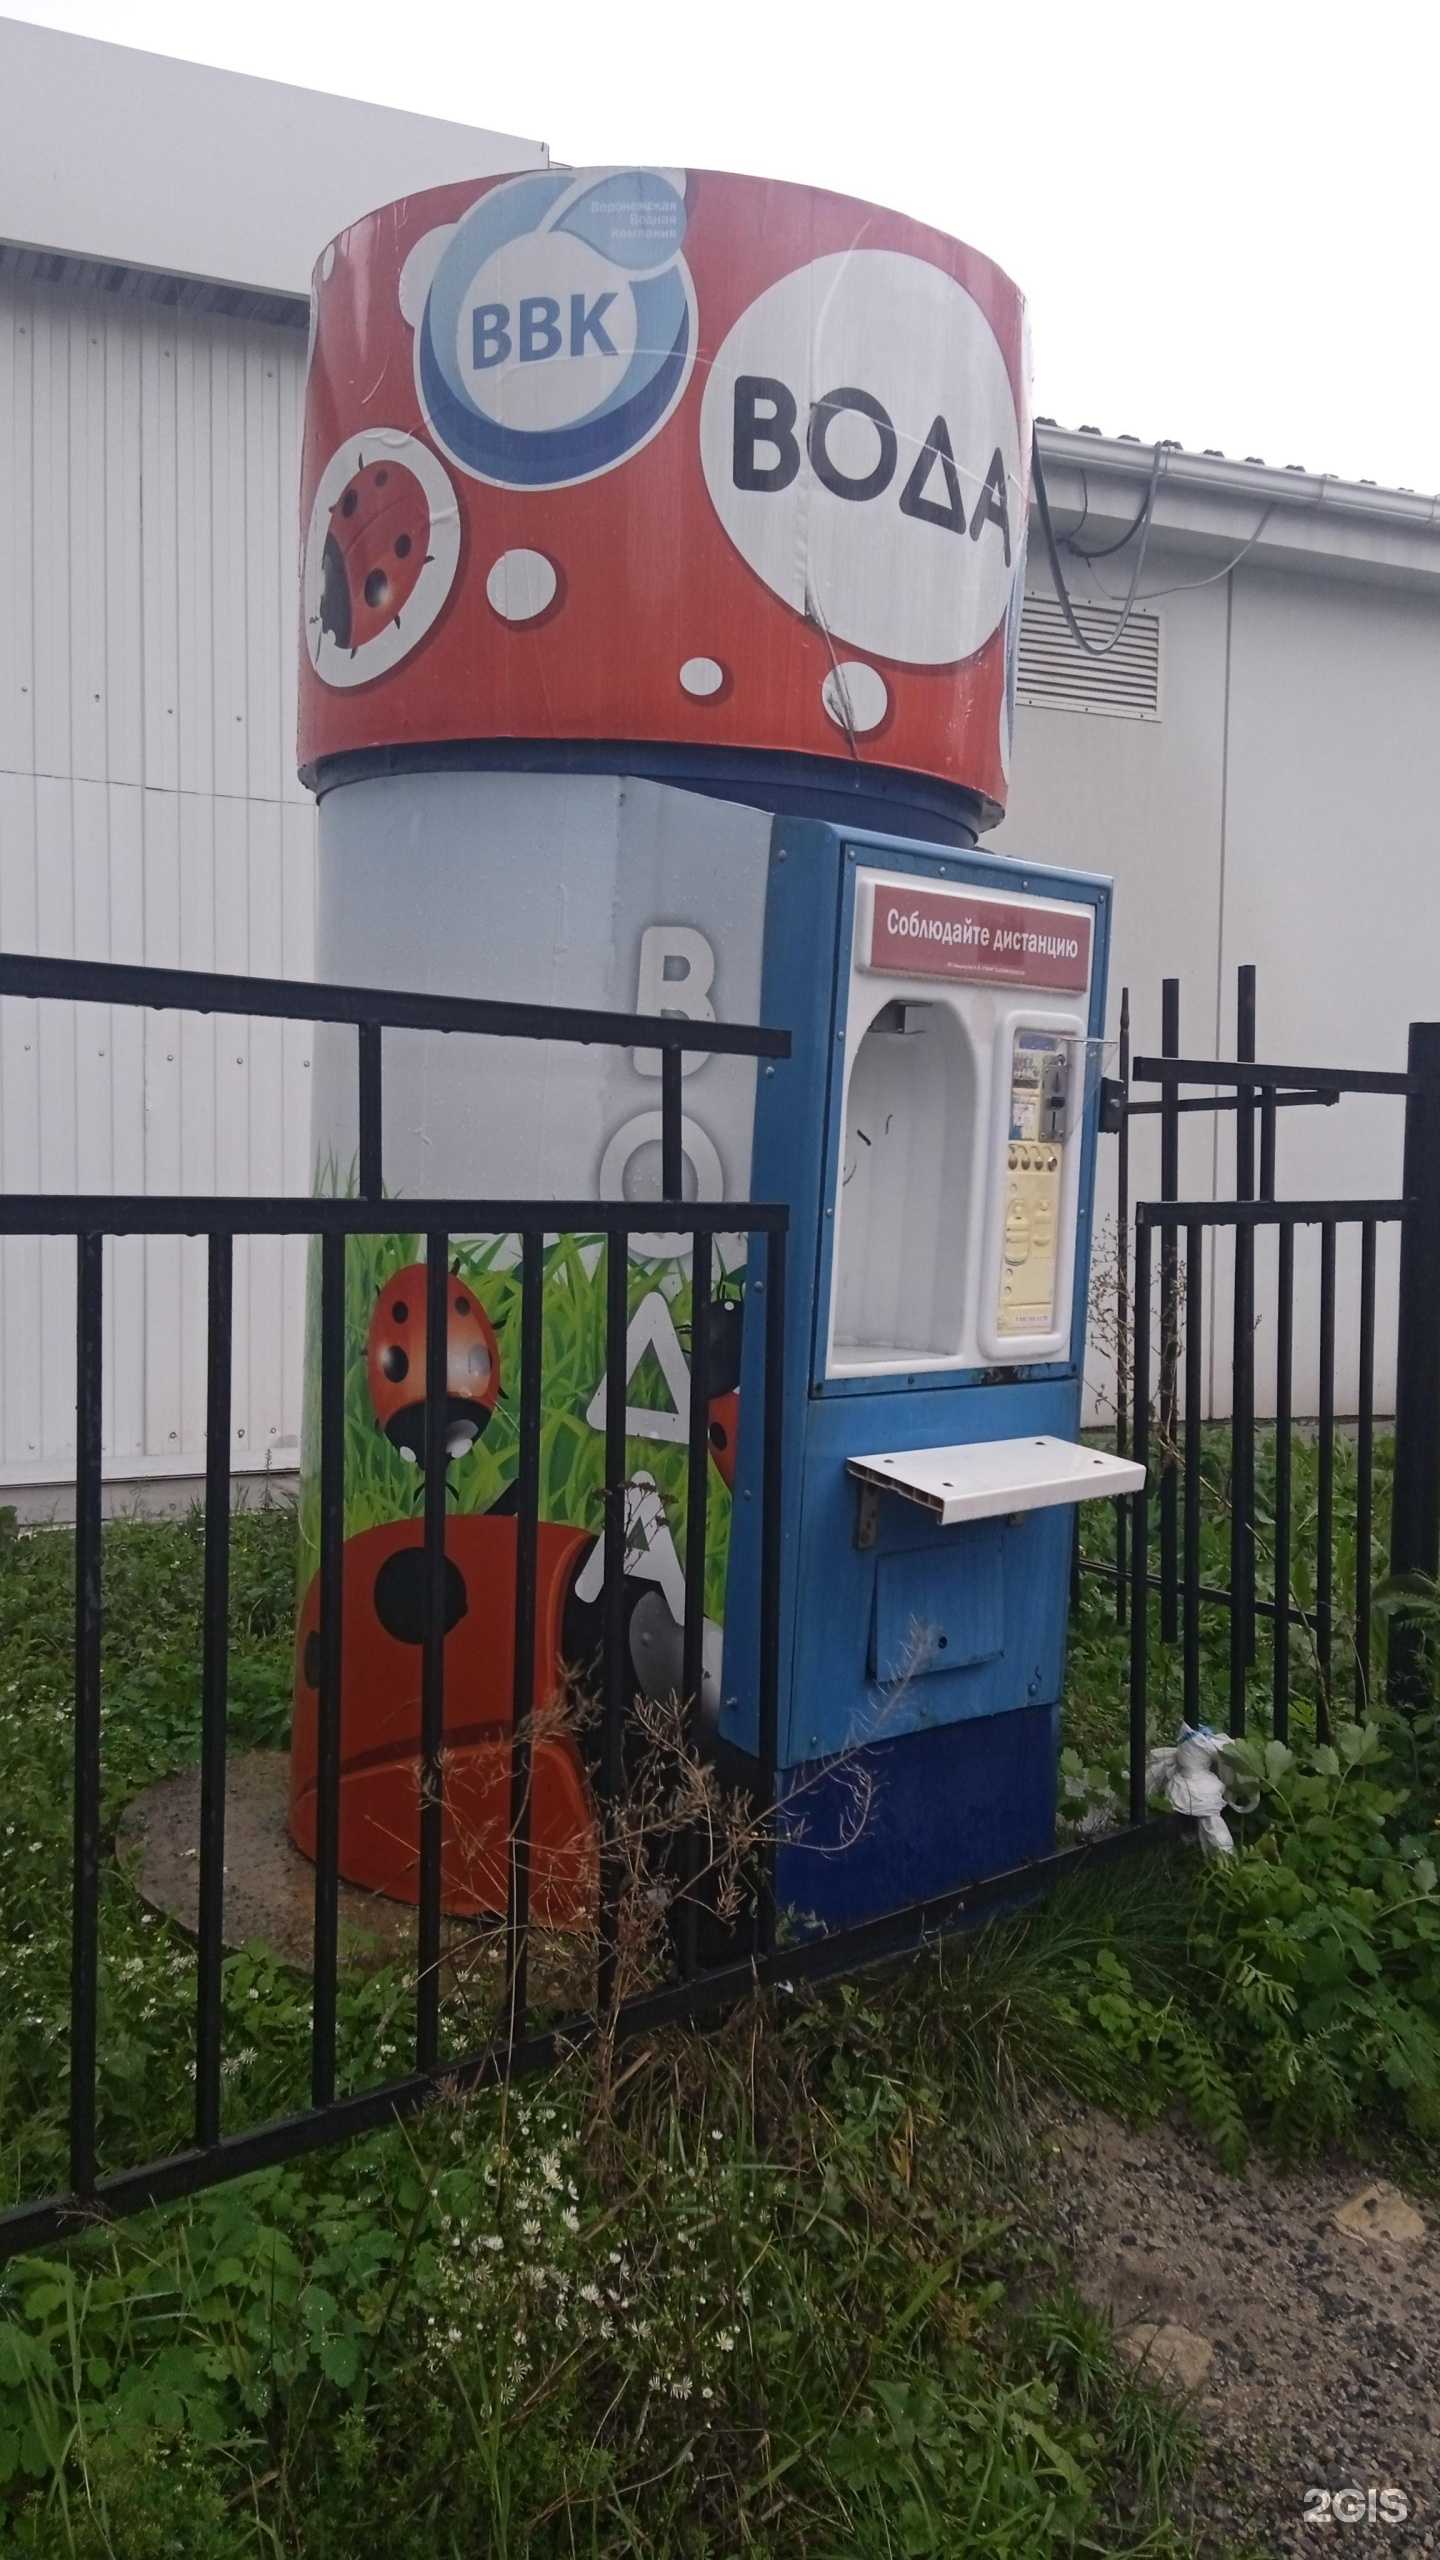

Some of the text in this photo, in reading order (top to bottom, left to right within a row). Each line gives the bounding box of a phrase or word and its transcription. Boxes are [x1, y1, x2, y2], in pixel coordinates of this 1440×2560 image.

[472, 292, 620, 370] ВВК
[732, 375, 1012, 568] ВОДА
[887, 908, 1078, 958] Соблюдайте дистанцию
